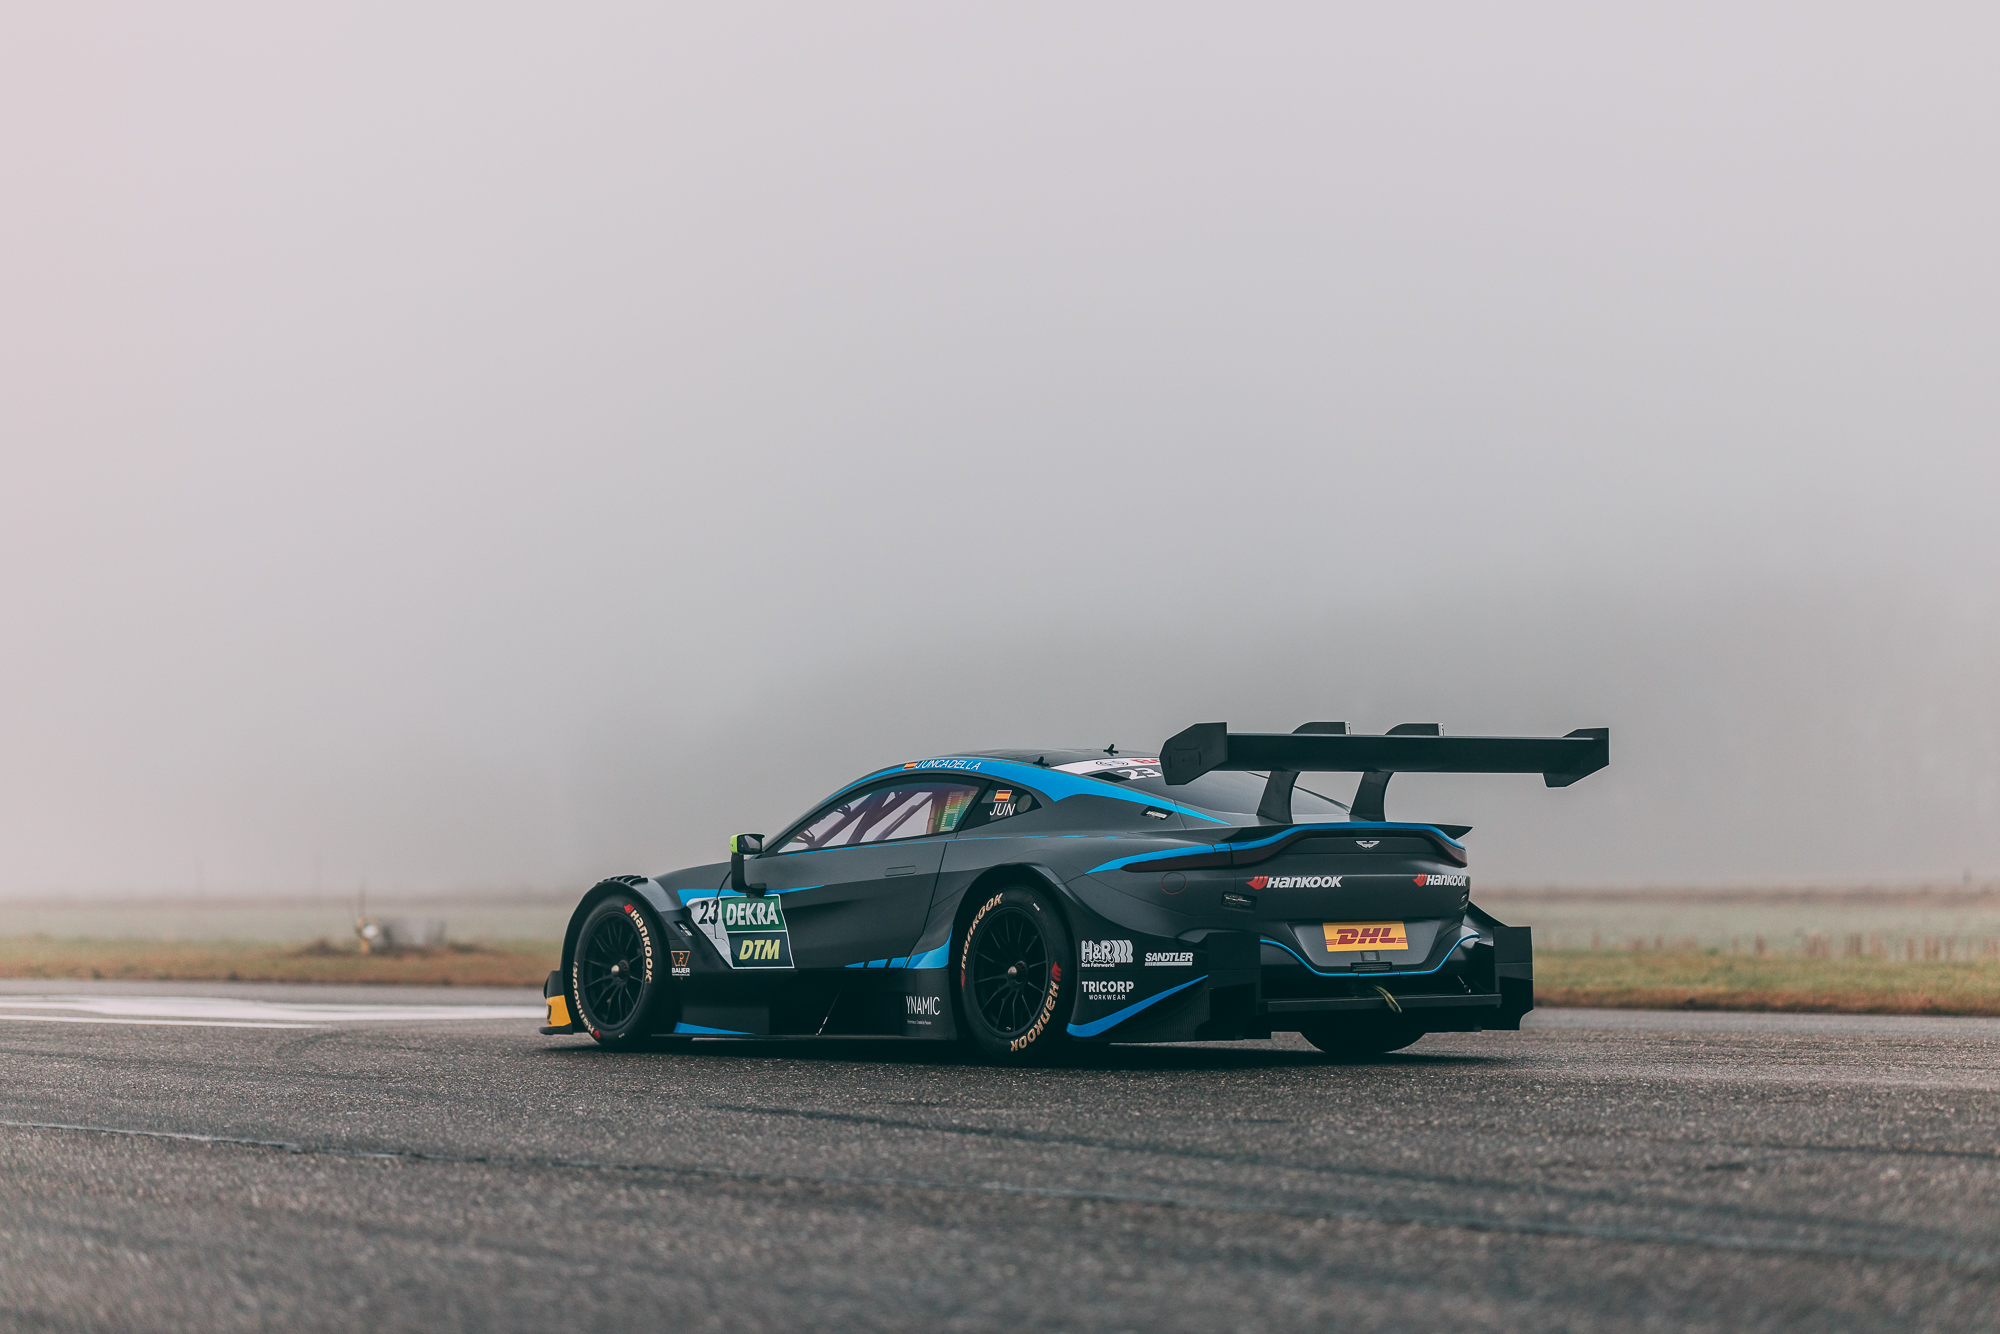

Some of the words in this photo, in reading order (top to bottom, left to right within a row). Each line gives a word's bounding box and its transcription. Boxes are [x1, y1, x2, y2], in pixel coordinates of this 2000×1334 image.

[915, 759, 982, 771] JUNCADELLA
[1116, 767, 1162, 780] 23
[989, 803, 1016, 816] JUN
[697, 900, 719, 925] 23
[726, 901, 780, 926] DEKRA
[1336, 927, 1397, 945] DHL
[739, 939, 781, 960] DTM
[1081, 940, 1114, 963] H&R
[1145, 952, 1194, 962] SANDTLER
[1081, 981, 1135, 993] TRICORP
[905, 995, 941, 1016] YNAMIC
